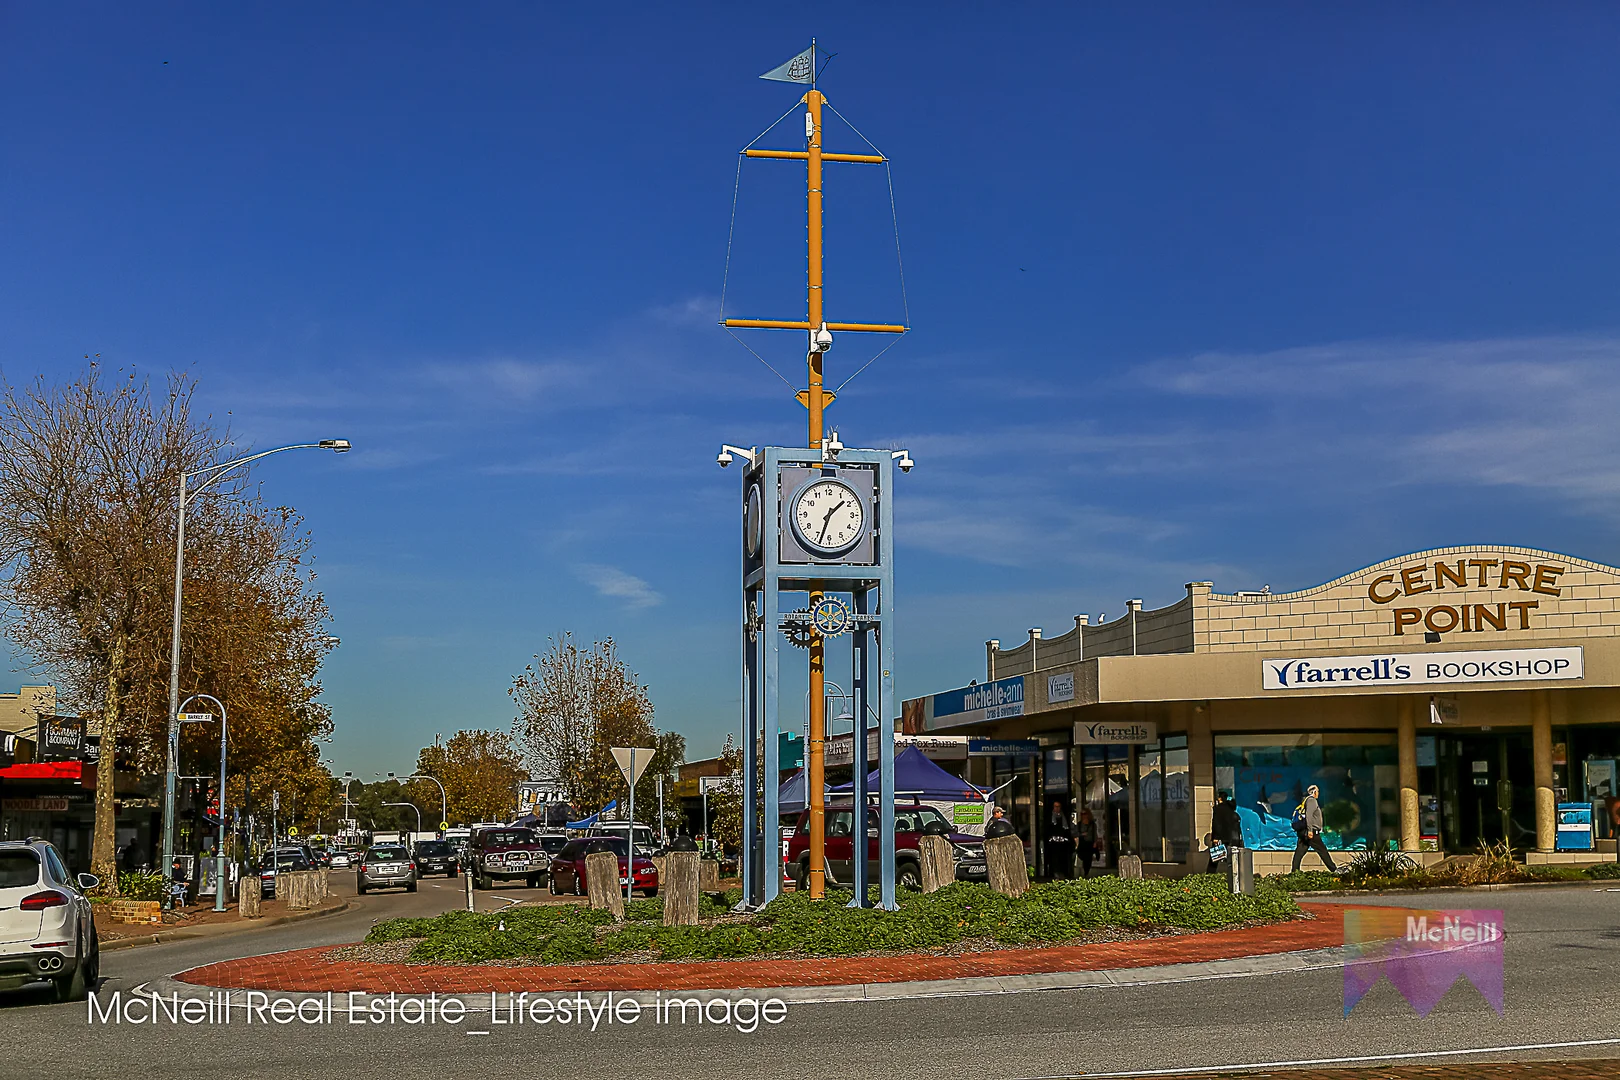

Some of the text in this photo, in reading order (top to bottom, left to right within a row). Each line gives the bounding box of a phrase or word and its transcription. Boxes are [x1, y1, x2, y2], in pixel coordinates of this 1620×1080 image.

[849, 511, 855, 519] 3
[838, 531, 844, 539] 5
[1368, 558, 1565, 604] CENTRE
[1393, 601, 1539, 635] POINT
[1294, 656, 1570, 684] farrell's BOOKSHOP
[964, 683, 1023, 711] michelle-ann
[1097, 725, 1148, 737] farrell's
[910, 738, 929, 748] Fox
[42, 800, 66, 810] LAND
